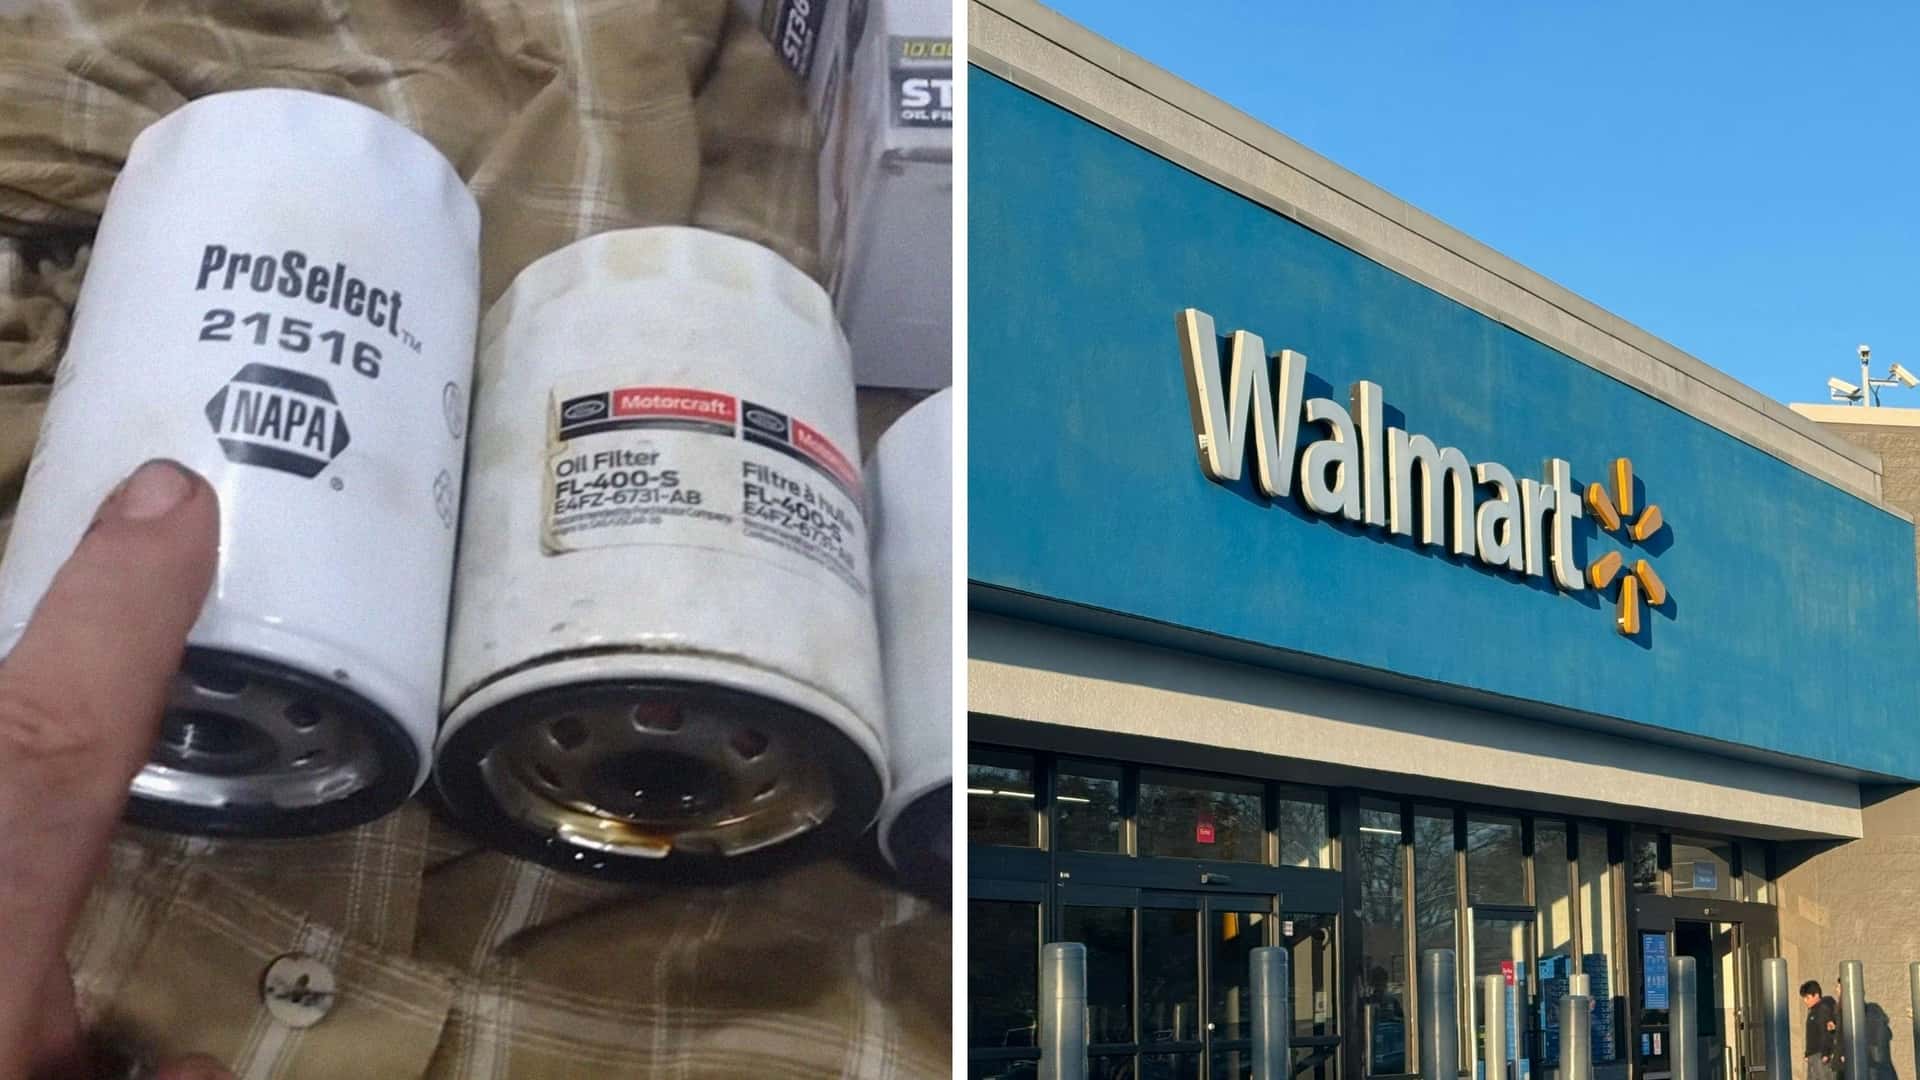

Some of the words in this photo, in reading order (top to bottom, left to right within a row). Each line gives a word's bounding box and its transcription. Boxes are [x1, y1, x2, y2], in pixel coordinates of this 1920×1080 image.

[902, 110, 929, 120] OIL
[195, 244, 402, 337] ProSelect
[198, 308, 383, 380] 21516
[231, 389, 326, 453] NAPA
[621, 395, 727, 416] Motorcraft
[556, 454, 587, 477] Oil
[593, 450, 660, 471] Filter
[1177, 308, 1585, 591] Walmart
[555, 470, 680, 499] FL-400-S
[743, 461, 801, 497] Filtre
